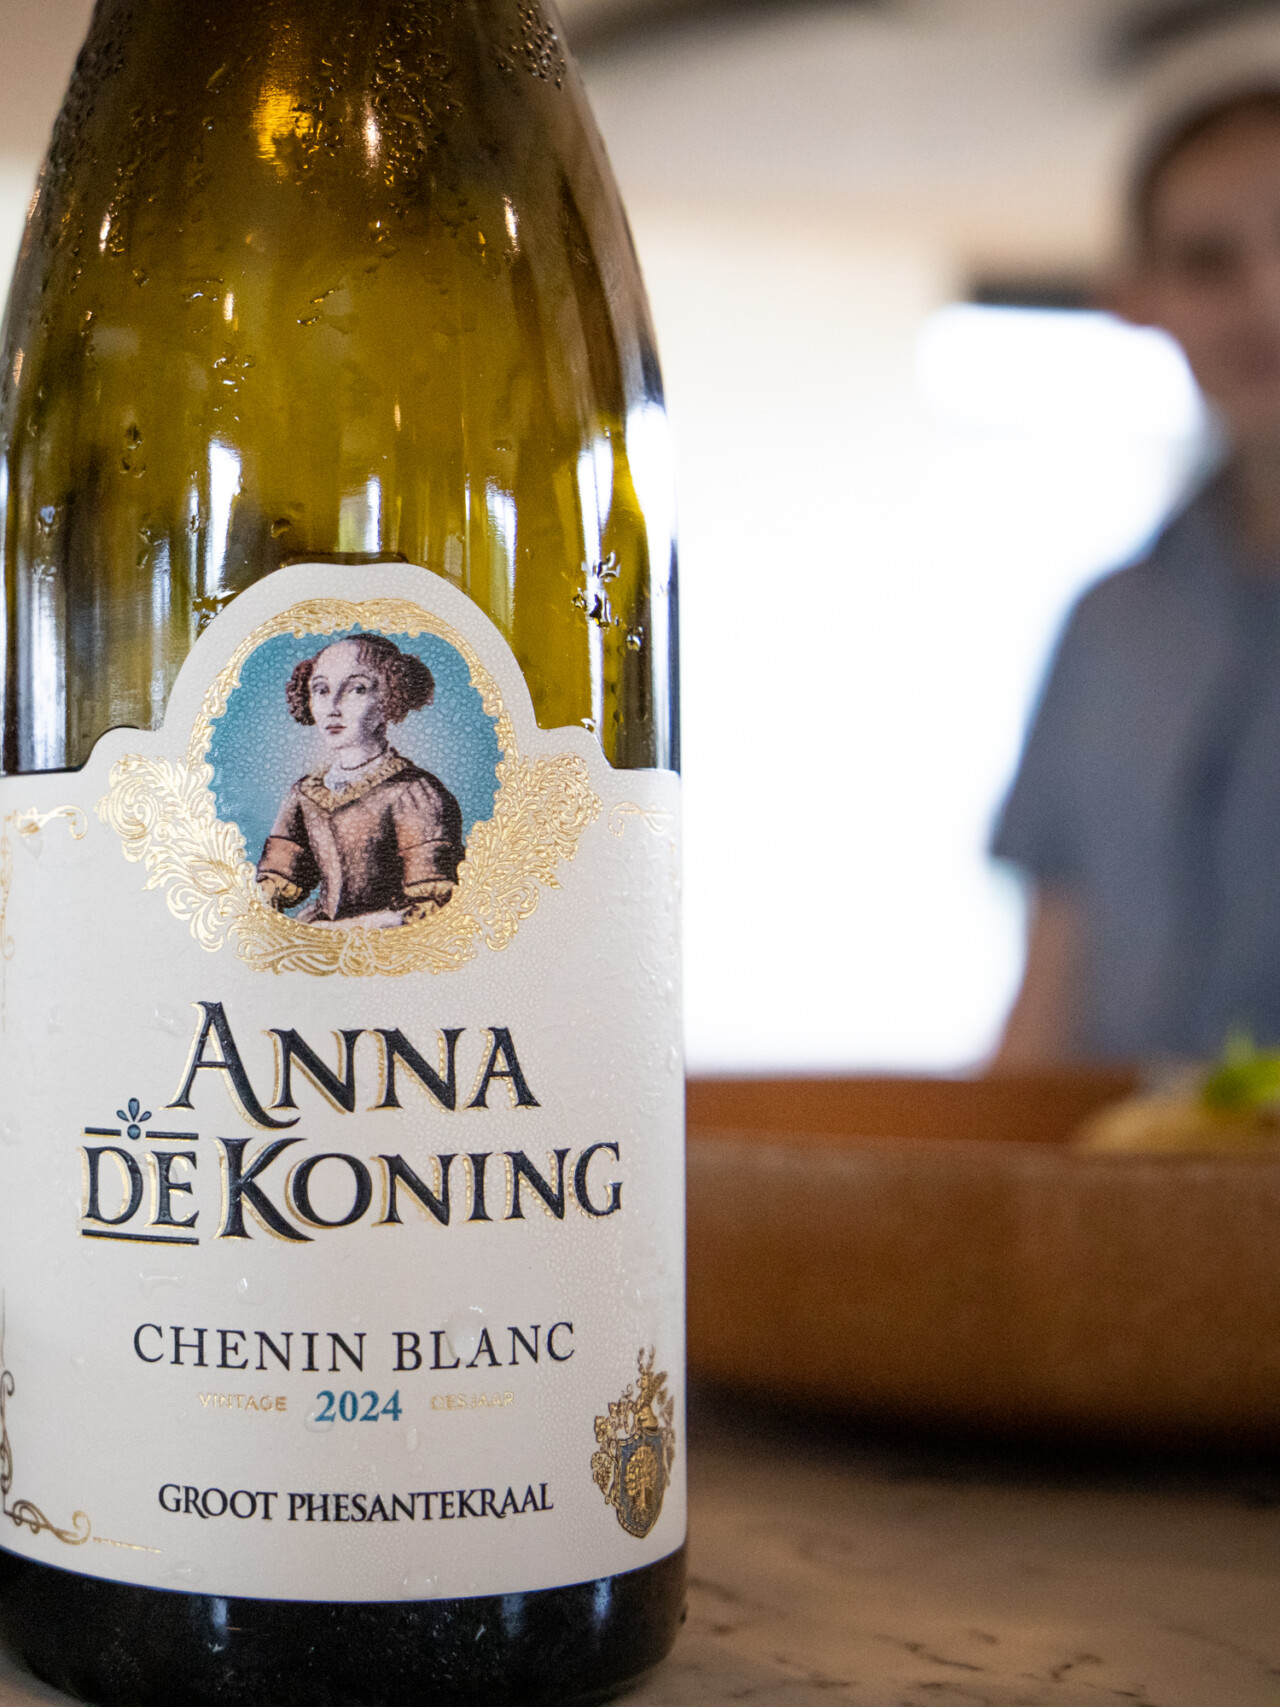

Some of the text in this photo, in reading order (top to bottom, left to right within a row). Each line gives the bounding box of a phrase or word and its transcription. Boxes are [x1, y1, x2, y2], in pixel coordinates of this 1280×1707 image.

[160, 1001, 541, 1130] ANNA
[78, 1137, 622, 1243] DE KONING
[134, 1322, 575, 1372] CHENIN BLANC
[198, 1393, 288, 1412] VINTAGE
[314, 1390, 403, 1423] 2024
[158, 1483, 554, 1522] GROOT PHESANTEKRAAL
